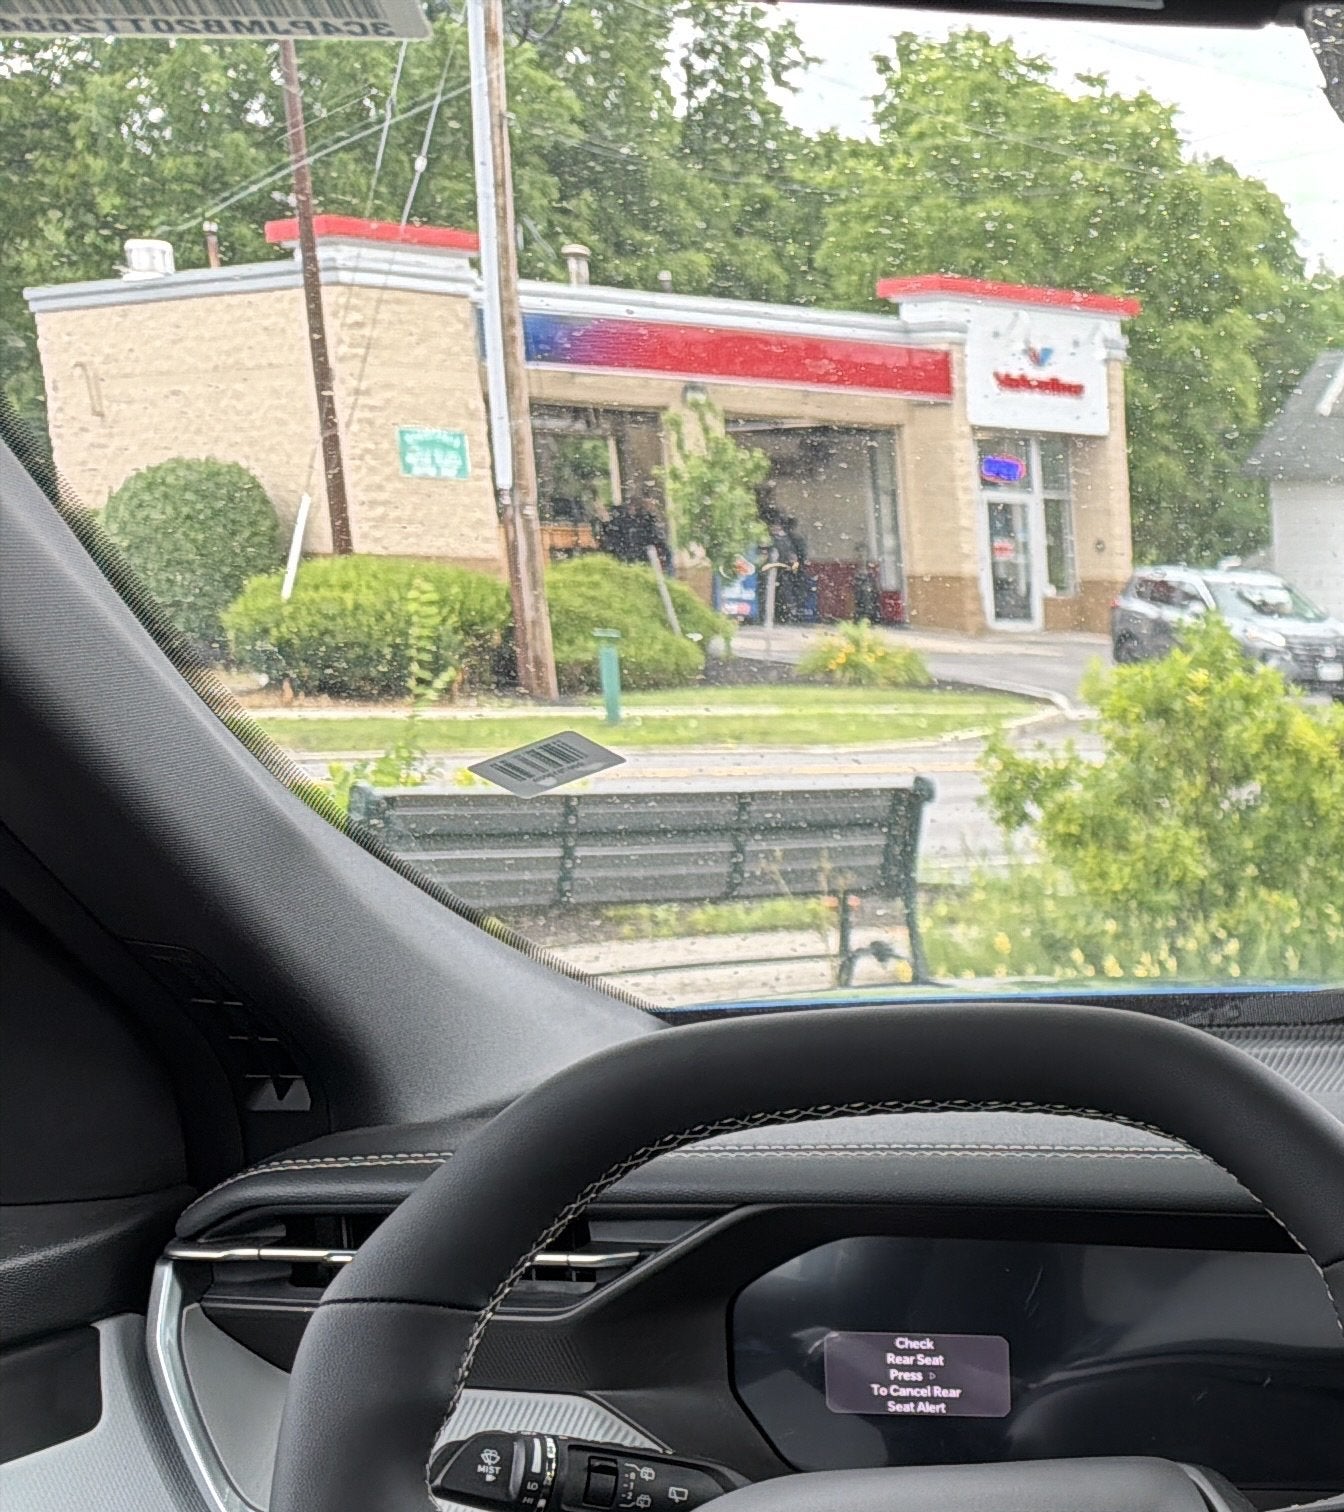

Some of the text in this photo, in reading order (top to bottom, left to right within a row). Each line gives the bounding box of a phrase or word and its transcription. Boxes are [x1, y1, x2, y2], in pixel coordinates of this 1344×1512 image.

[895, 1337, 935, 1349] Check
[886, 1353, 945, 1366] Rear Seat
[889, 1368, 923, 1381] Press
[870, 1384, 962, 1398] To Cancel Rear
[887, 1400, 947, 1413] Seat Alert
[476, 1464, 502, 1475] MIST
